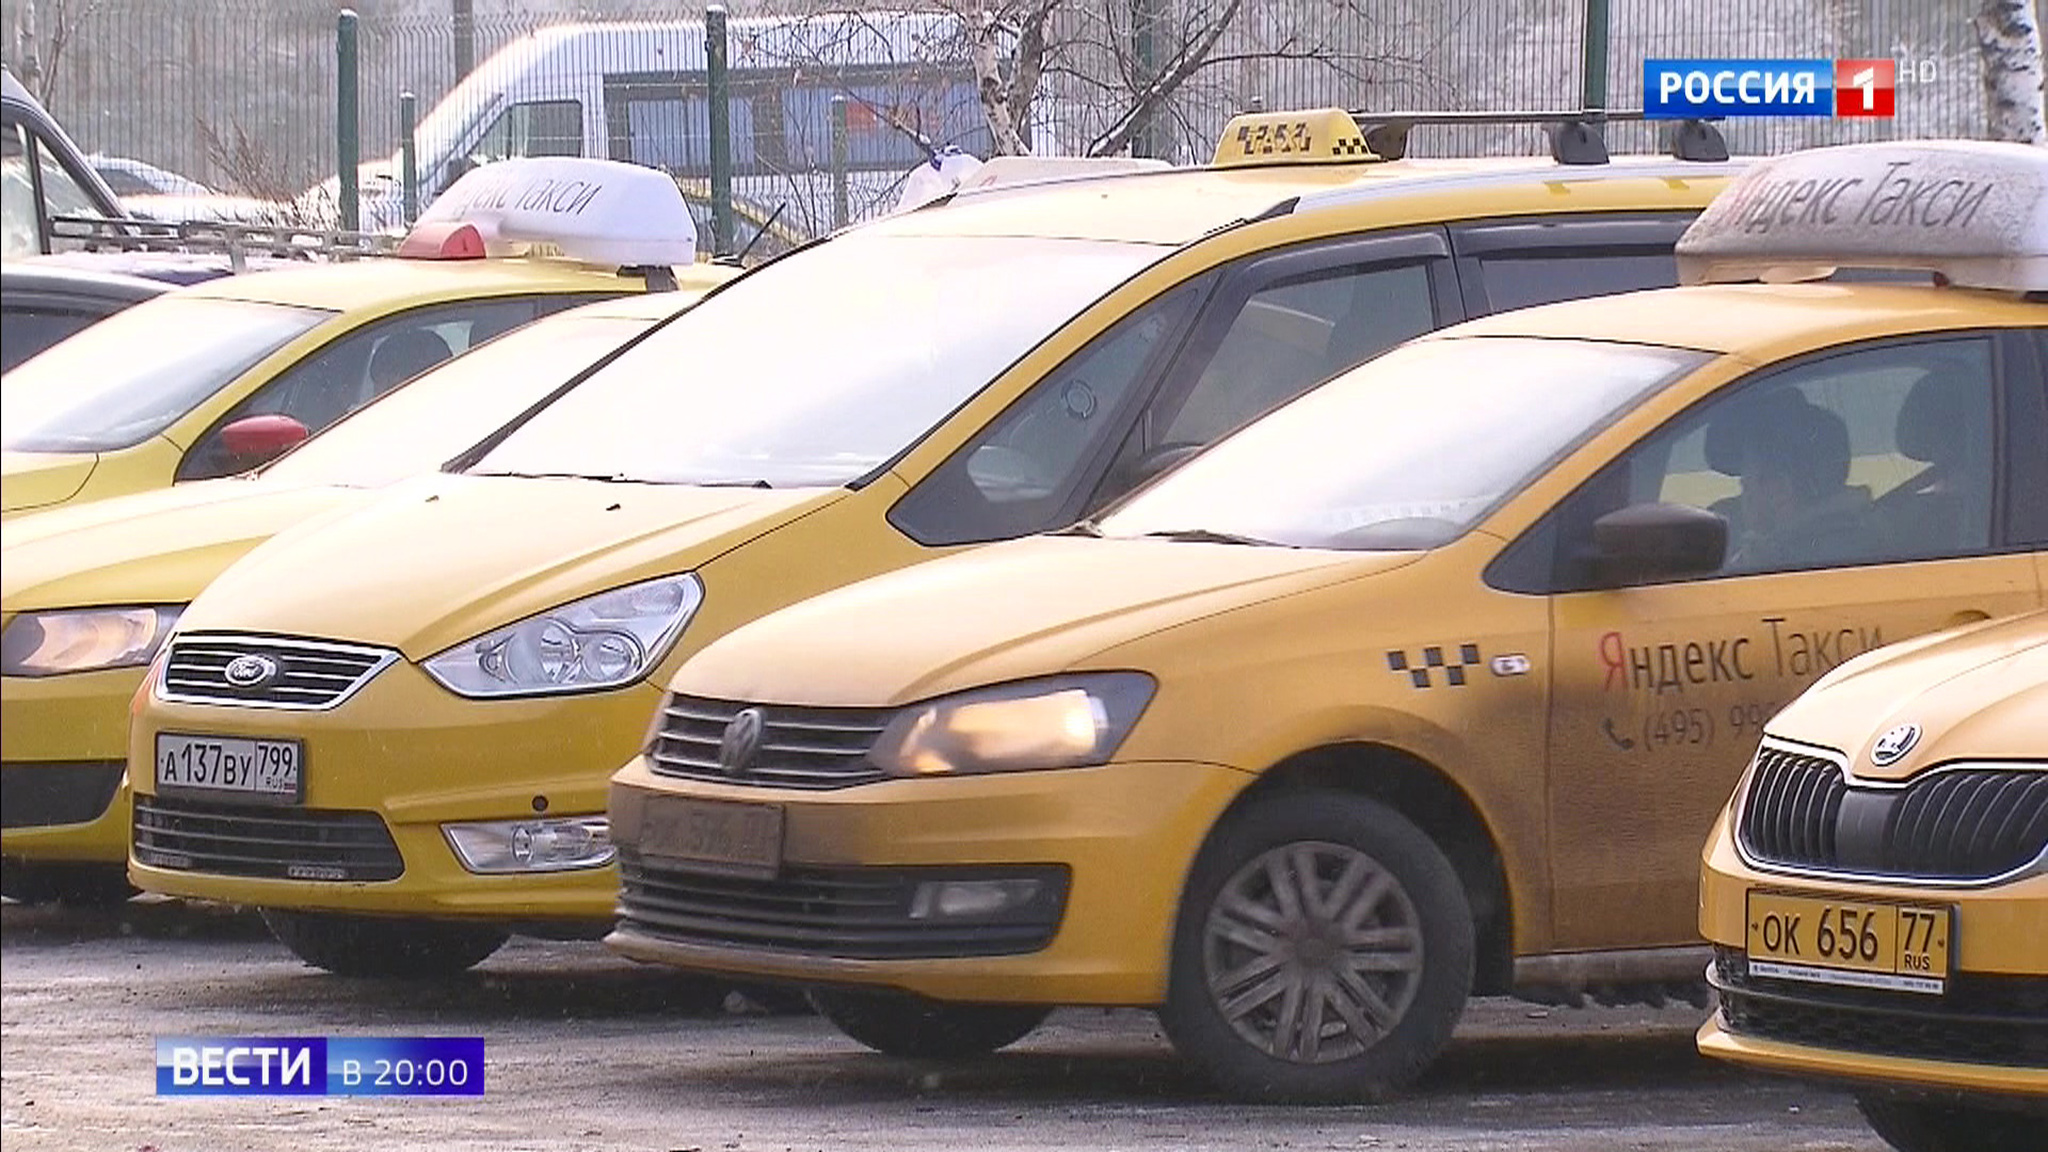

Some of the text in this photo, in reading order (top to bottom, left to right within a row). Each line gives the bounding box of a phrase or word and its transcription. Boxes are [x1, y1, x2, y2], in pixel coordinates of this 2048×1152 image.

[1855, 161, 1995, 229] Такси
[1600, 631, 1754, 694] Яндекс
[1643, 707, 1715, 751] (495)
[257, 745, 293, 777] 799
[265, 777, 284, 789] RUS
[1817, 907, 1878, 962] 656
[1901, 912, 1935, 953] 77
[1904, 954, 1931, 971] RUS
